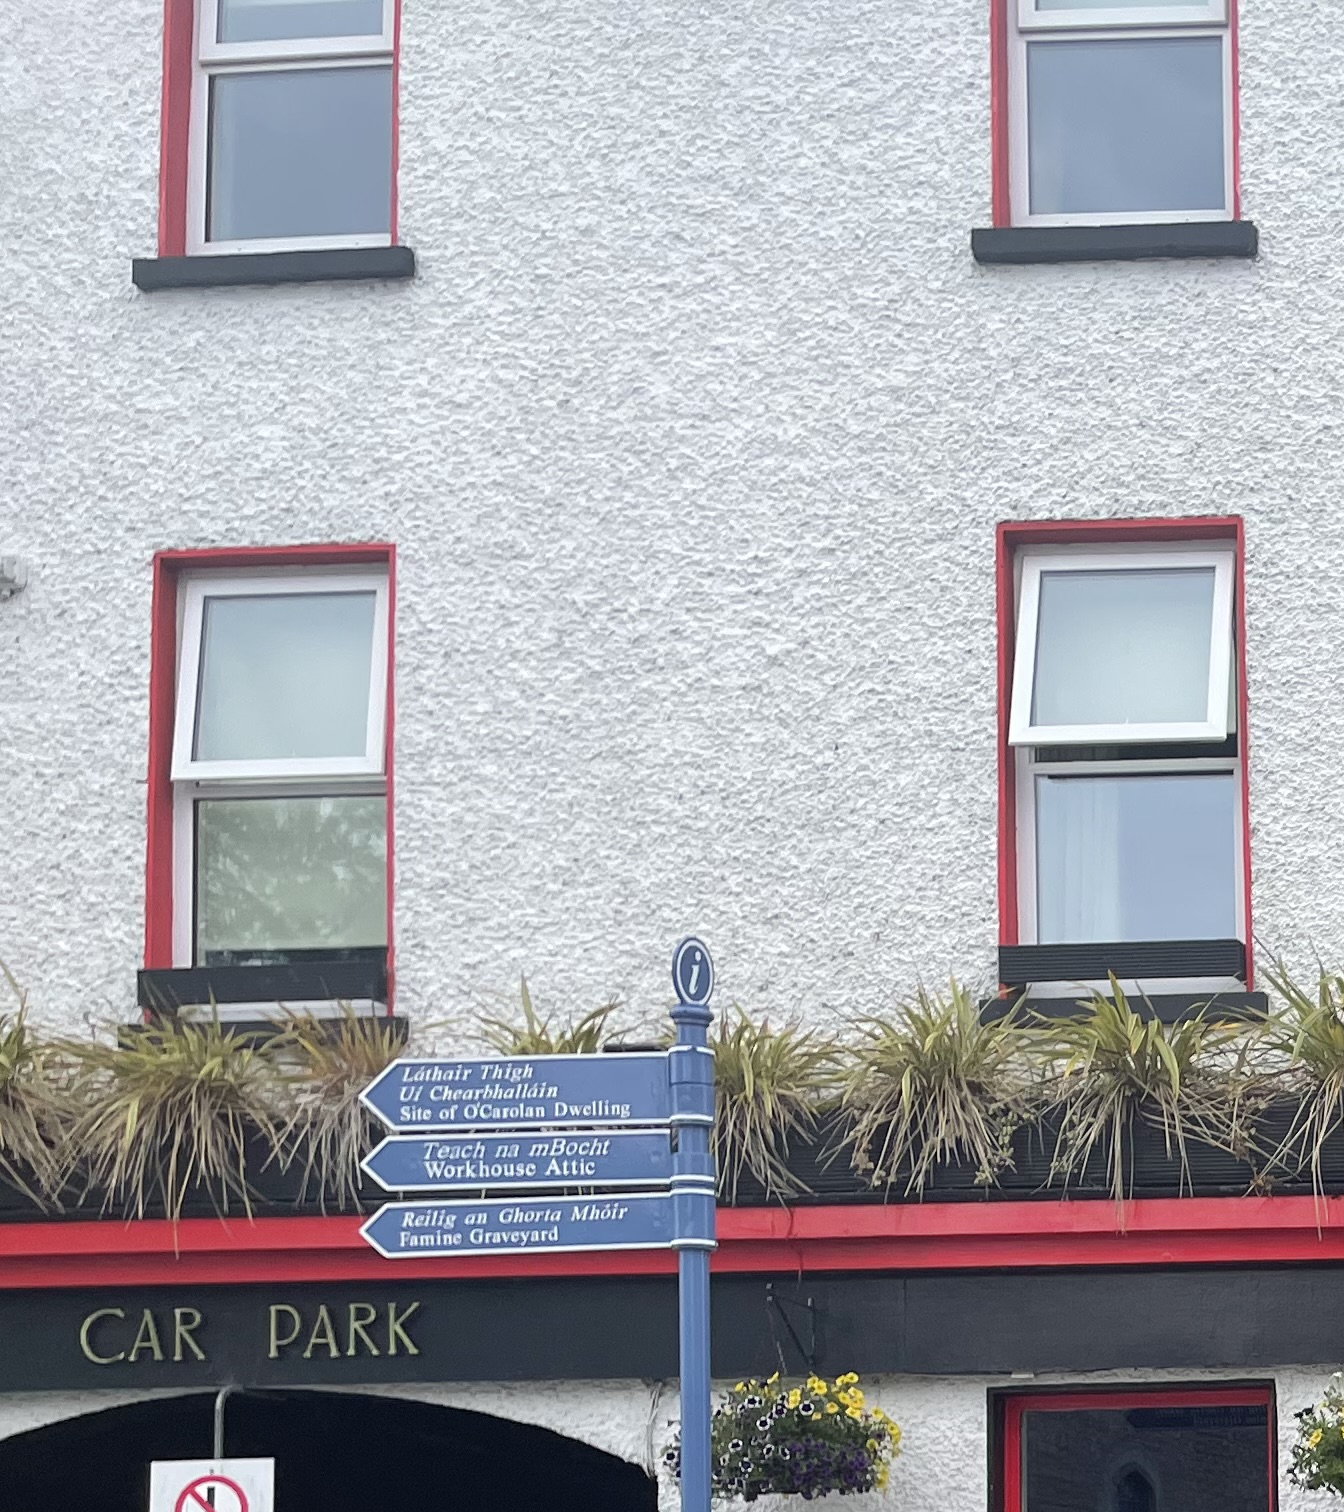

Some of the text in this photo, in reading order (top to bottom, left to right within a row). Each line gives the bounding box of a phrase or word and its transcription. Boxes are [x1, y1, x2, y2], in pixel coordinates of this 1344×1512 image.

[402, 1063, 533, 1082] Láthair Thigh
[430, 1082, 559, 1101] Chearbhalláin
[400, 1100, 631, 1121] Site of O'Carolan Dwelling
[424, 1138, 611, 1159] Teach na mBocht
[424, 1158, 596, 1179] Workhouse Attic
[402, 1203, 629, 1229] Reilig an Ghorta Mhóir
[400, 1225, 559, 1248] Famine Graveyard
[79, 1301, 421, 1364] CAR PARK
